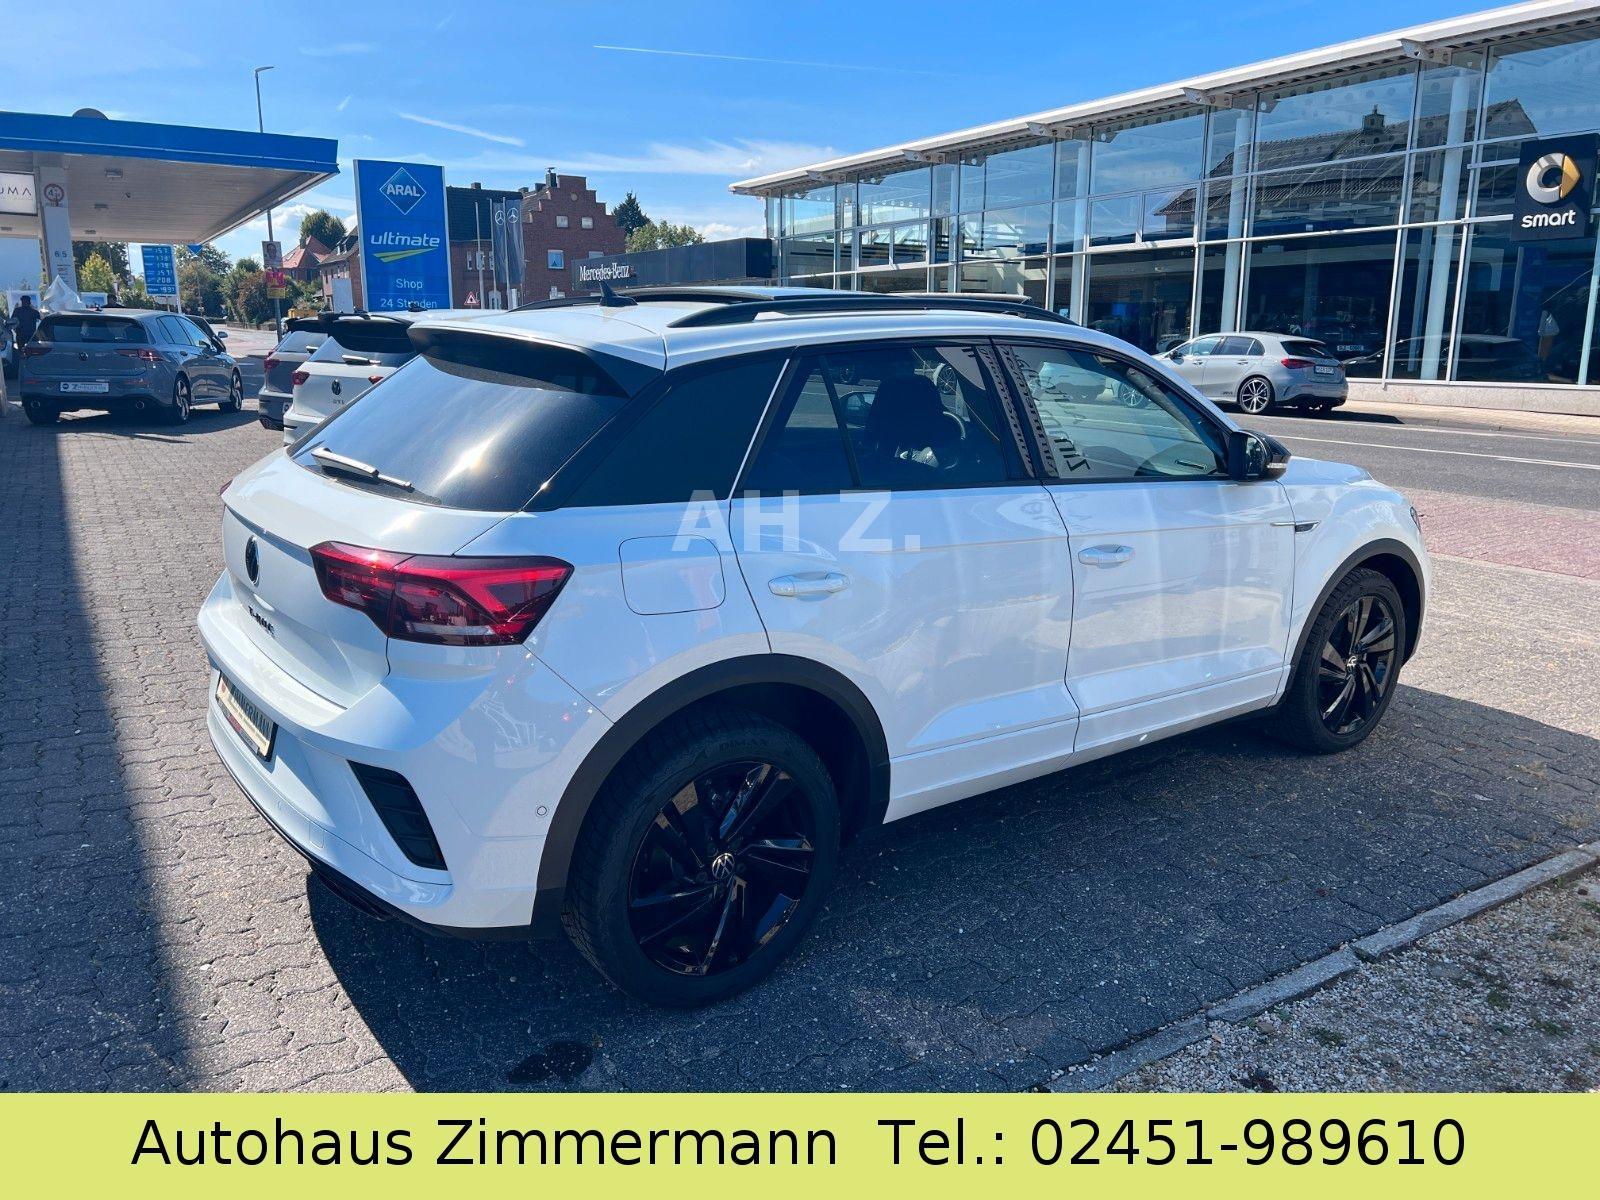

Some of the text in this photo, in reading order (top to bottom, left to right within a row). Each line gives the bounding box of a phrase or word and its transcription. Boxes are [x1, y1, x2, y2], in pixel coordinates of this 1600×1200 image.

[386, 183, 420, 197] ARAL
[1521, 209, 1576, 228] smart
[370, 231, 440, 247] ultimate
[579, 262, 630, 281] Mercedes-Benz
[395, 278, 423, 289] Shop
[380, 299, 394, 308] 24
